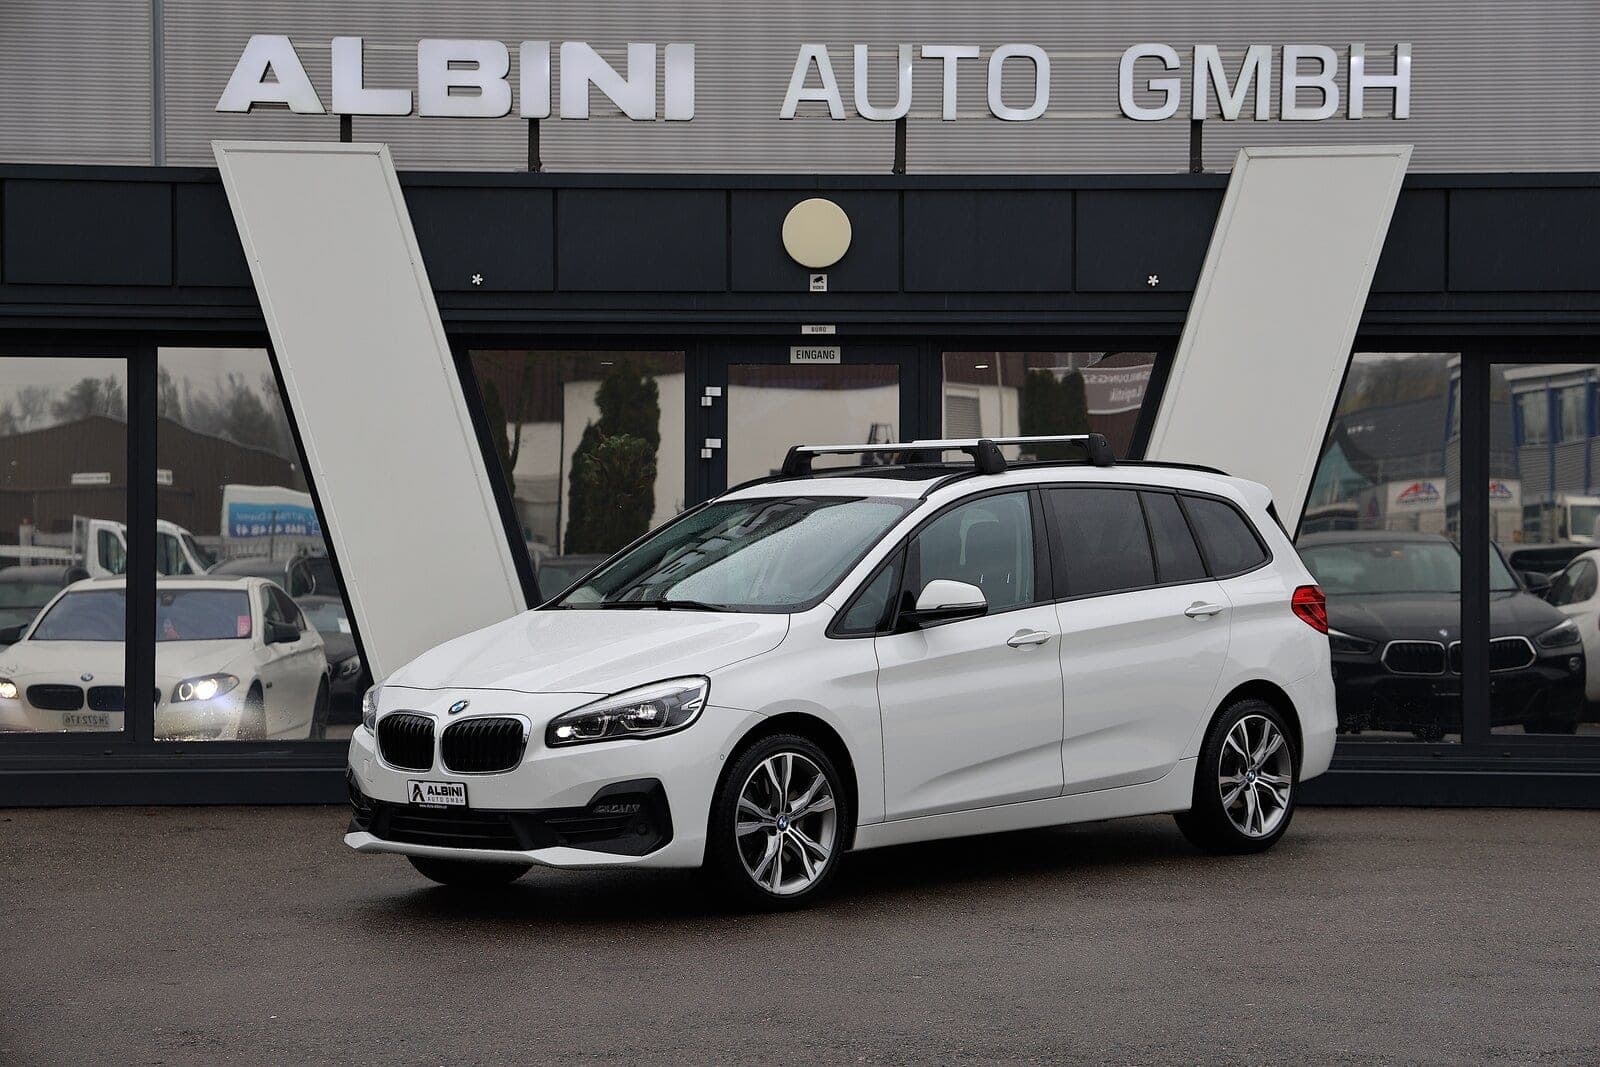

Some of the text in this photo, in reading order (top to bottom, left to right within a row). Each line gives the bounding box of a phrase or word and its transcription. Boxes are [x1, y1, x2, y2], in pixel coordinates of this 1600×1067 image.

[215, 34, 1412, 121] ALBINI AUTO GMBH
[796, 349, 835, 360] EINGANG
[427, 785, 463, 797] ALBINI
